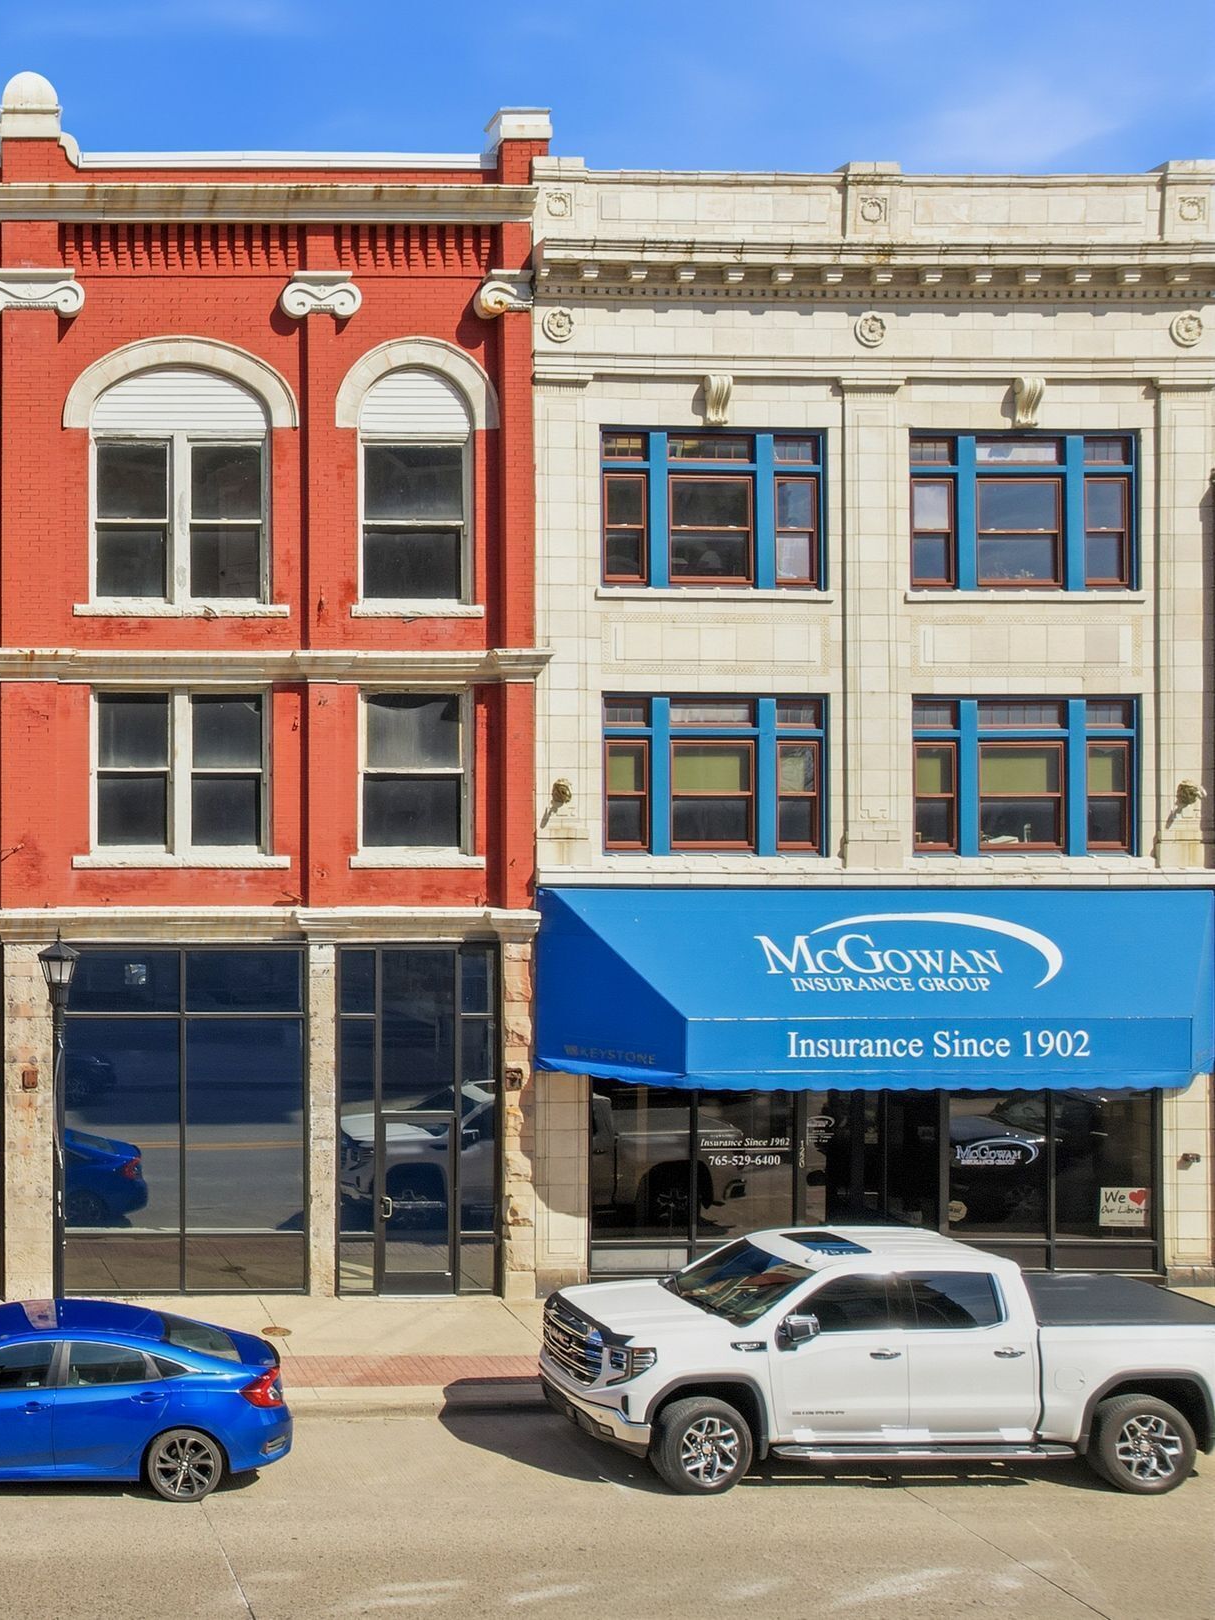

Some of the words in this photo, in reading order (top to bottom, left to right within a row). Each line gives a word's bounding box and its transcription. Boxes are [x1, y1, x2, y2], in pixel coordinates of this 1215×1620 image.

[754, 934, 1003, 974] McGOWAN
[790, 977, 915, 992] INSURANCE
[918, 977, 991, 992] GROUP
[787, 1031, 923, 1058] Insurance
[933, 1030, 1011, 1058] Since
[1022, 1030, 1091, 1058] 1902
[580, 1045, 657, 1065] KEYSTONE
[700, 1138, 743, 1147] Insurance
[744, 1137, 768, 1147] Since
[770, 1137, 790, 1147] 1902
[708, 1154, 781, 1166] 765-529-6400
[1104, 1190, 1126, 1203] We
[1101, 1205, 1115, 1214] Our
[1118, 1205, 1149, 1215] Library
